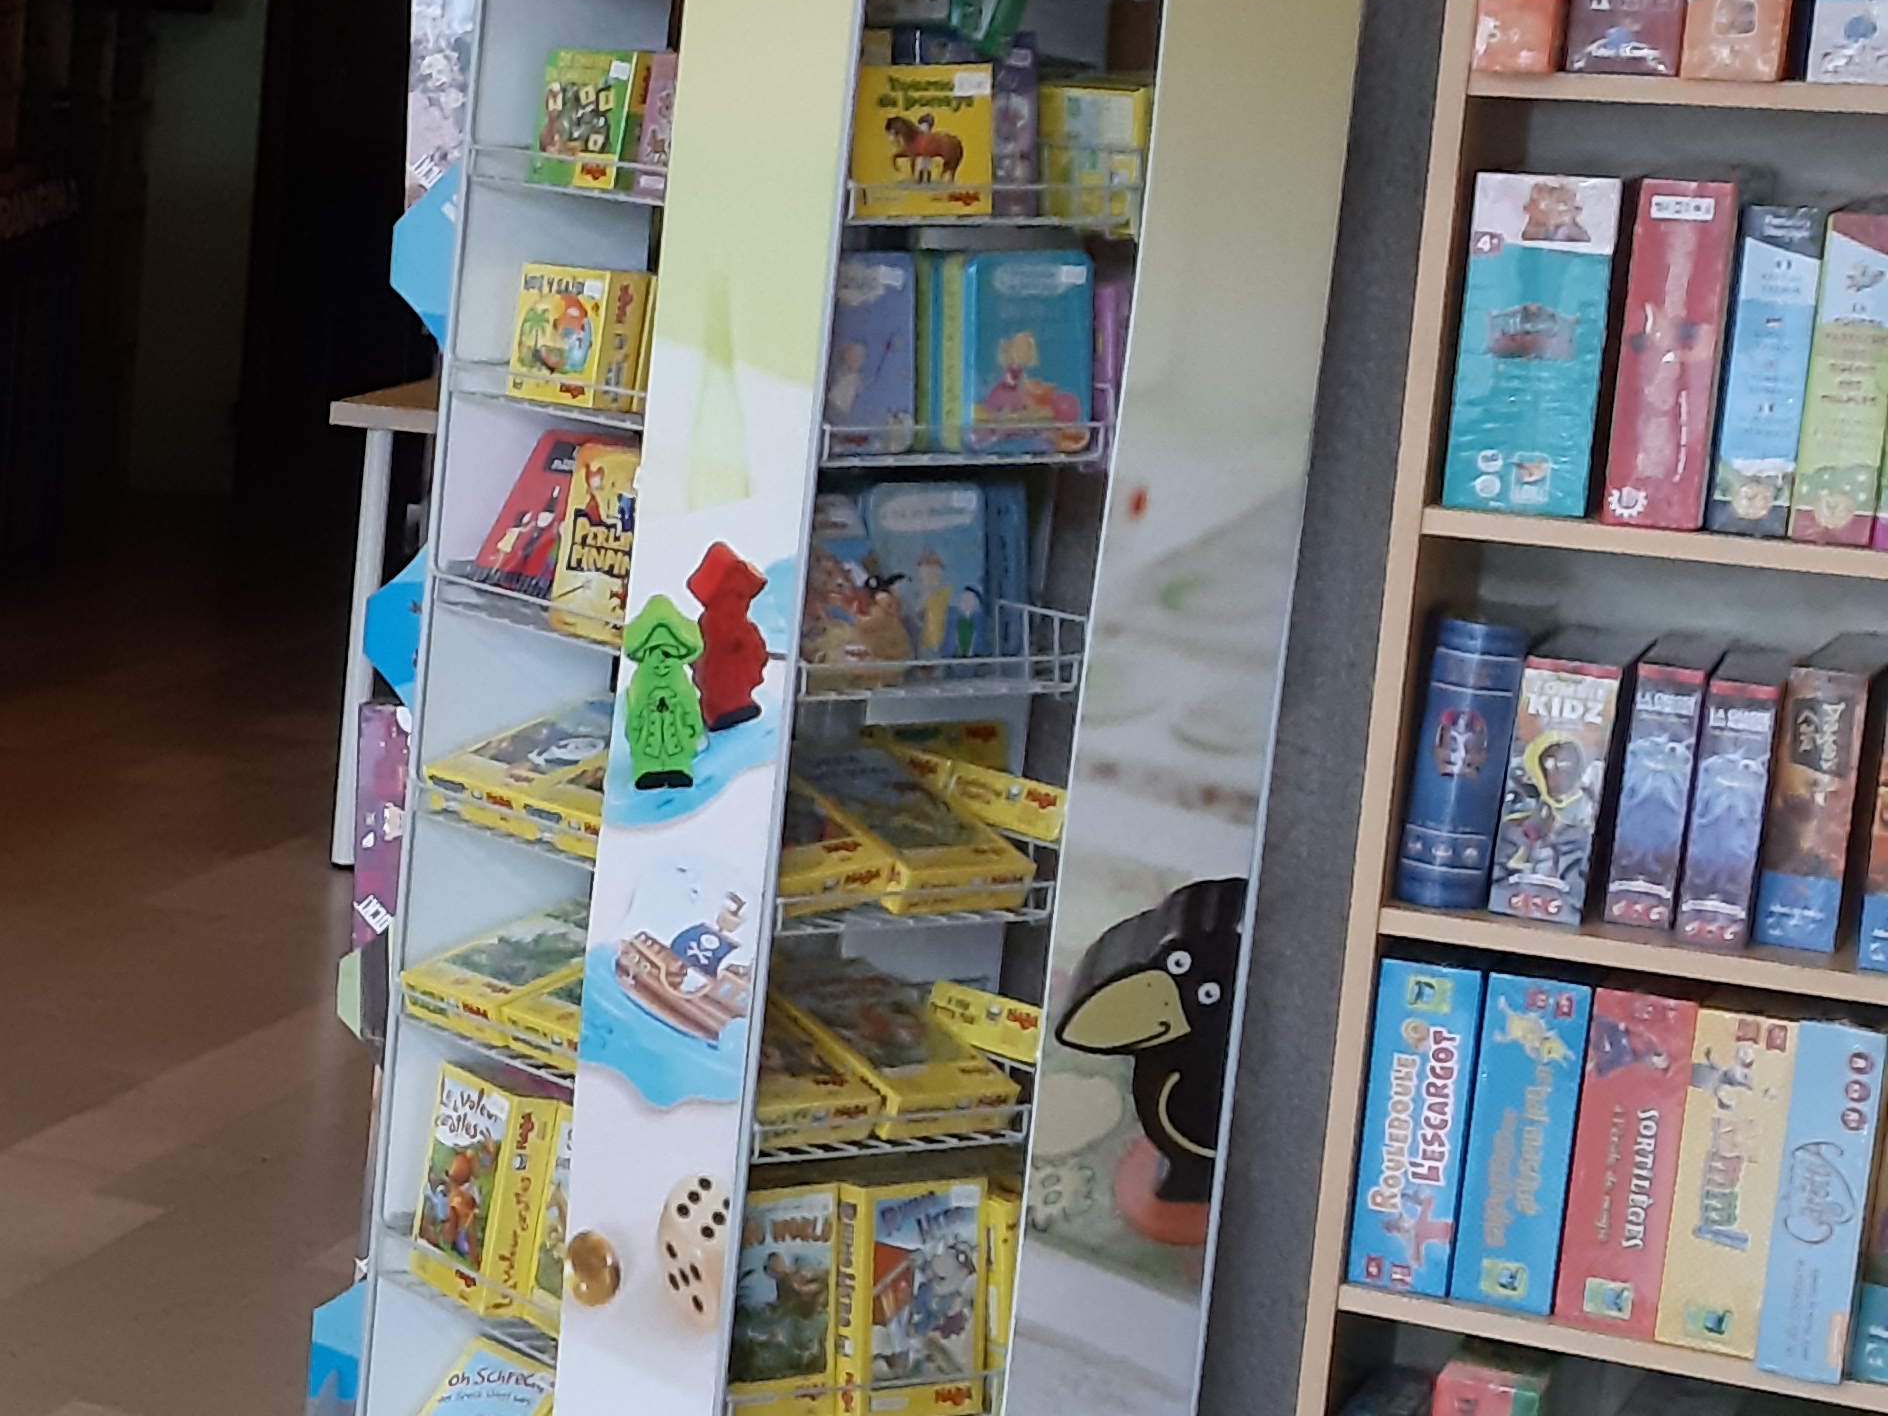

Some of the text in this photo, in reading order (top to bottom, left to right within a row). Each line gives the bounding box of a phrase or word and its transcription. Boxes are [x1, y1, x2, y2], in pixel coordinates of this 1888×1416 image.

[1525, 694, 1604, 725] KIDZ
[1409, 1026, 1461, 1185] L'ESCARGOT
[1620, 1108, 1660, 1249] SORTILÈGES
